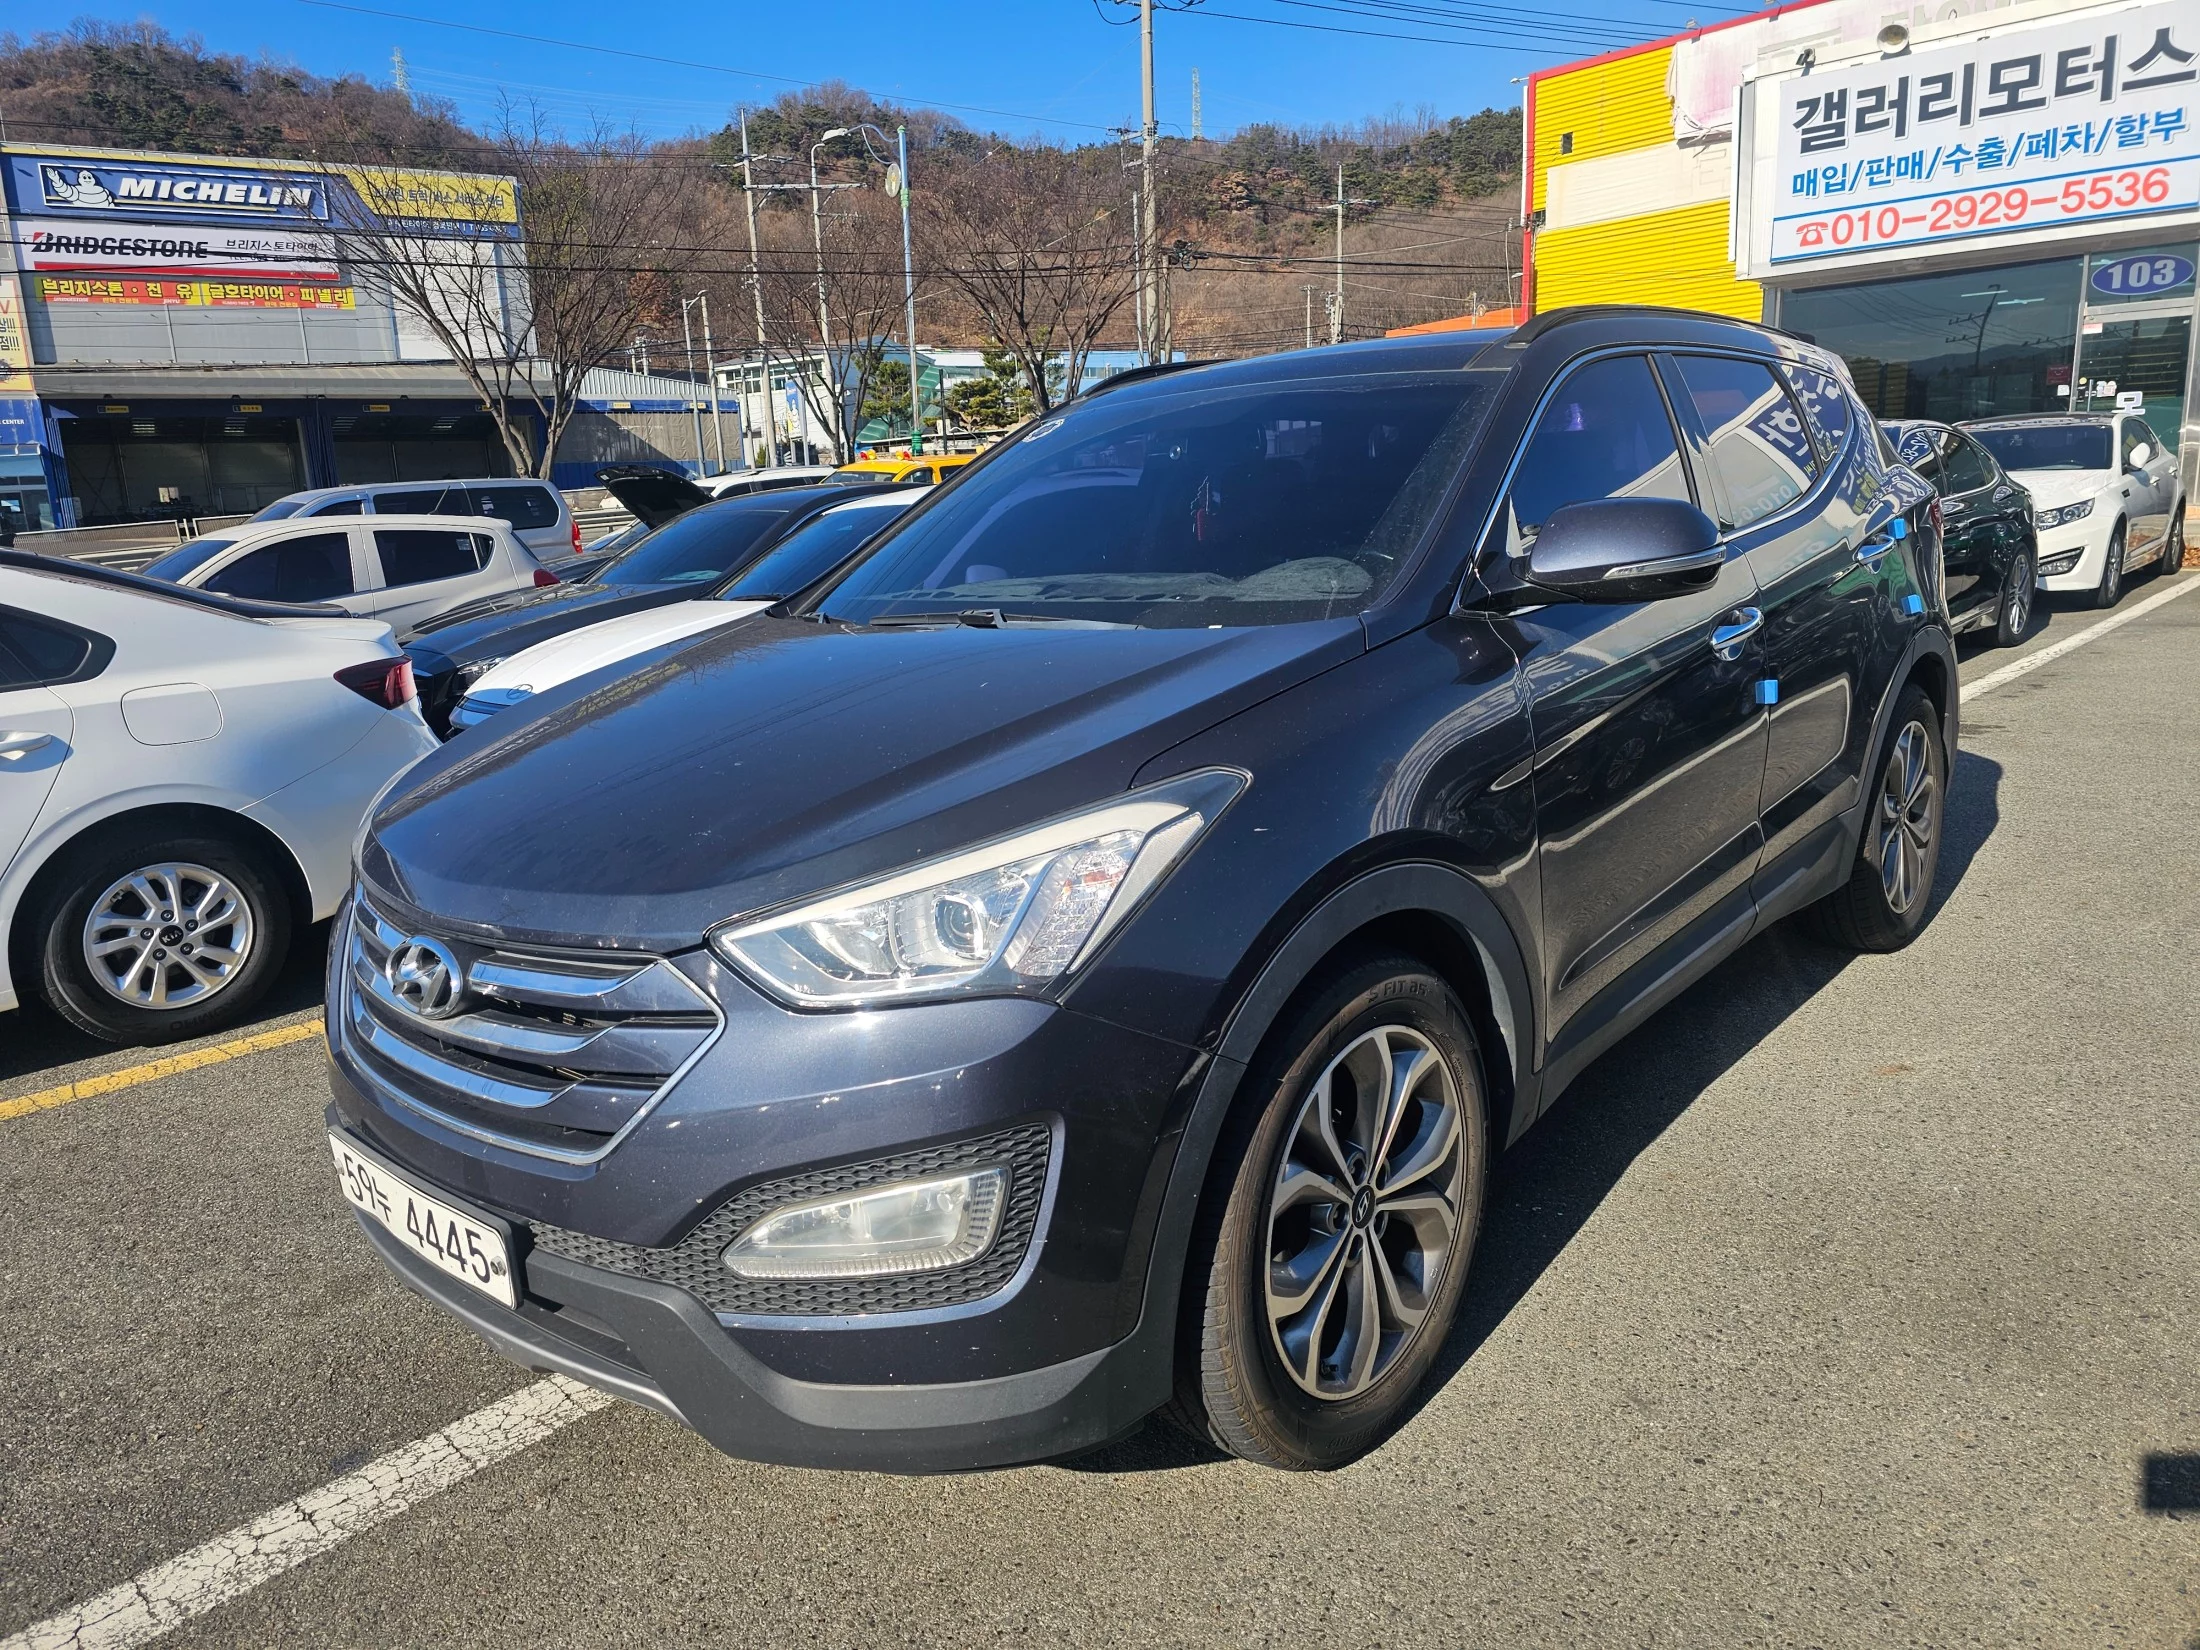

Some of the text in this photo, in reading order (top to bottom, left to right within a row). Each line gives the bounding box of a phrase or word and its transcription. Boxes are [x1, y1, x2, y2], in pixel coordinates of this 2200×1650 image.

[1793, 25, 2199, 154] 갤러리모터스
[1792, 107, 2187, 200] 매입/판매/수출/폐차/할부
[118, 176, 313, 207] MICHELIN
[1831, 167, 2170, 246] 010-2929-5536
[31, 231, 209, 259] BRIDGESTONE
[42, 279, 124, 297] 브리지스톤
[209, 283, 284, 301] 금호타이어
[2107, 259, 2176, 290] 103
[343, 1152, 491, 1284] 59누 4445
